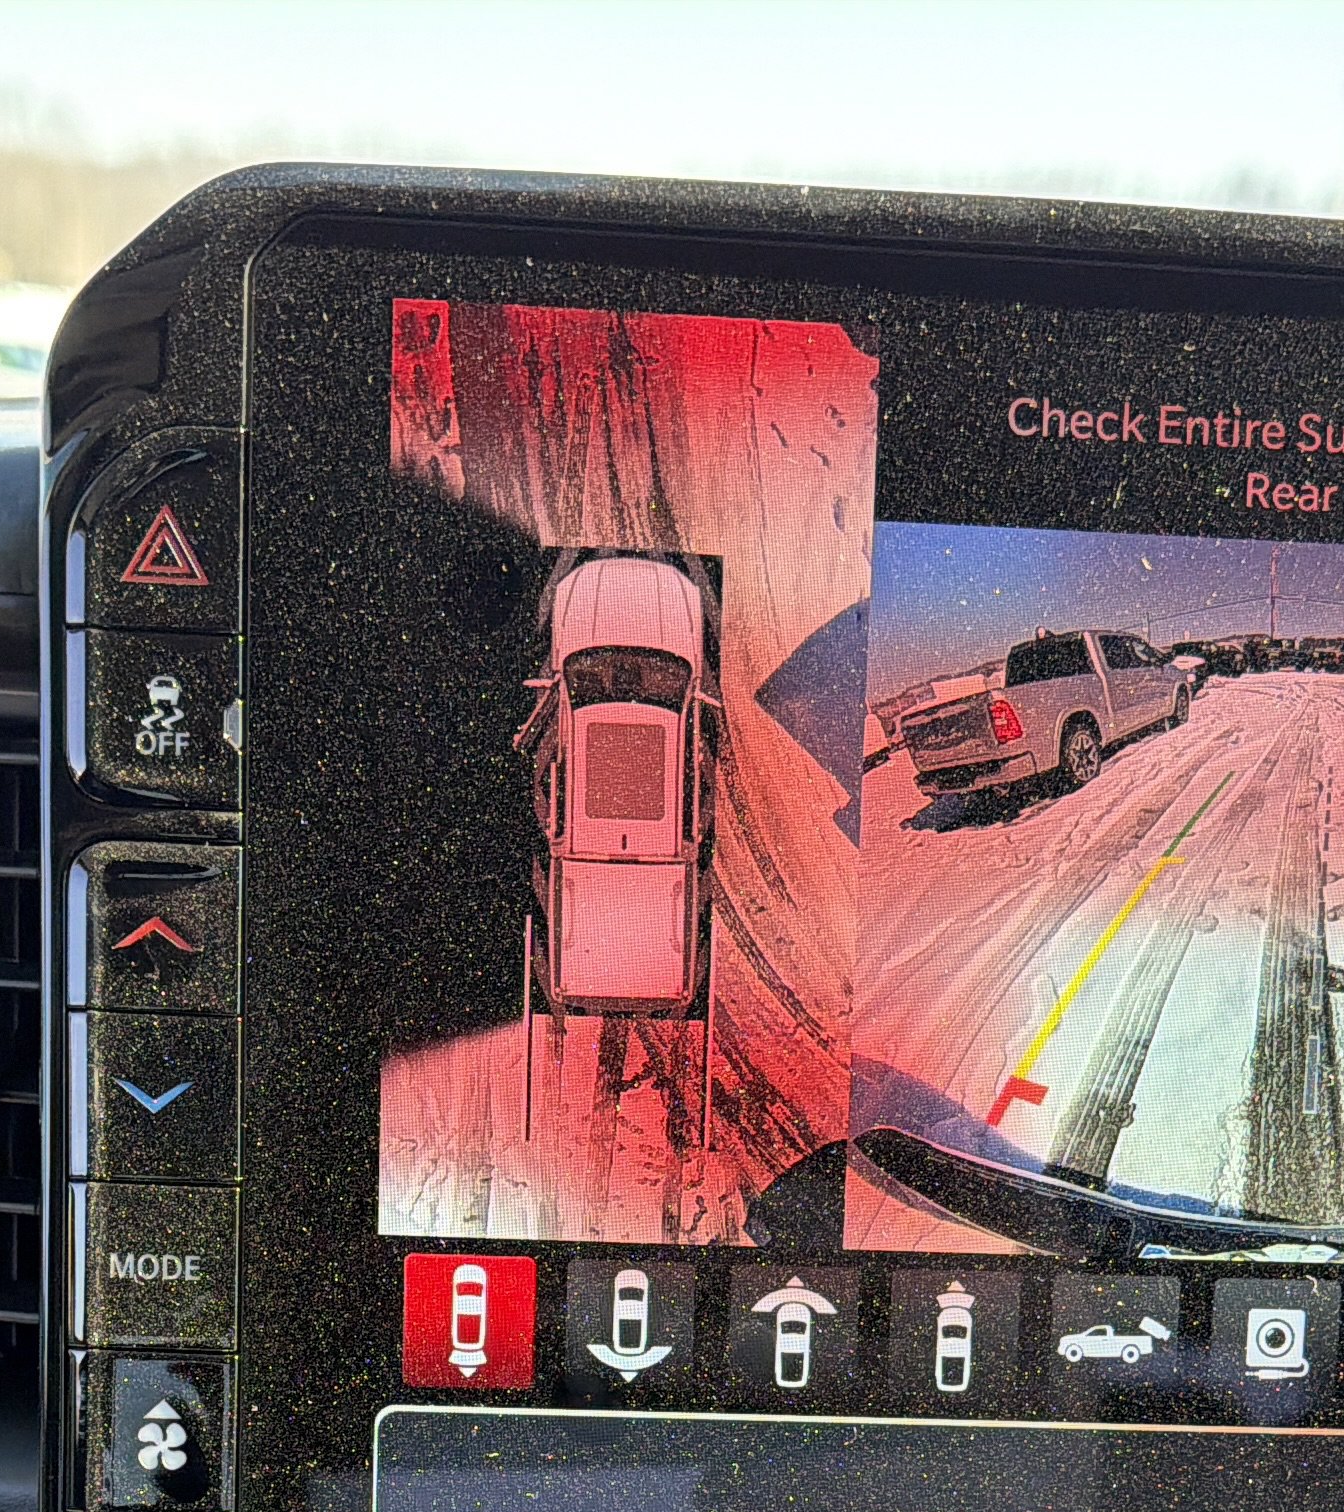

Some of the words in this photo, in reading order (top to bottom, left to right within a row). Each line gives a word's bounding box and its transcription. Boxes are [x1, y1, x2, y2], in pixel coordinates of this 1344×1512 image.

[1006, 396, 1145, 446] Check
[1158, 404, 1286, 452] Entire
[1245, 472, 1339, 514] Rear
[135, 730, 190, 756] OFF
[110, 1252, 202, 1282] MODE
